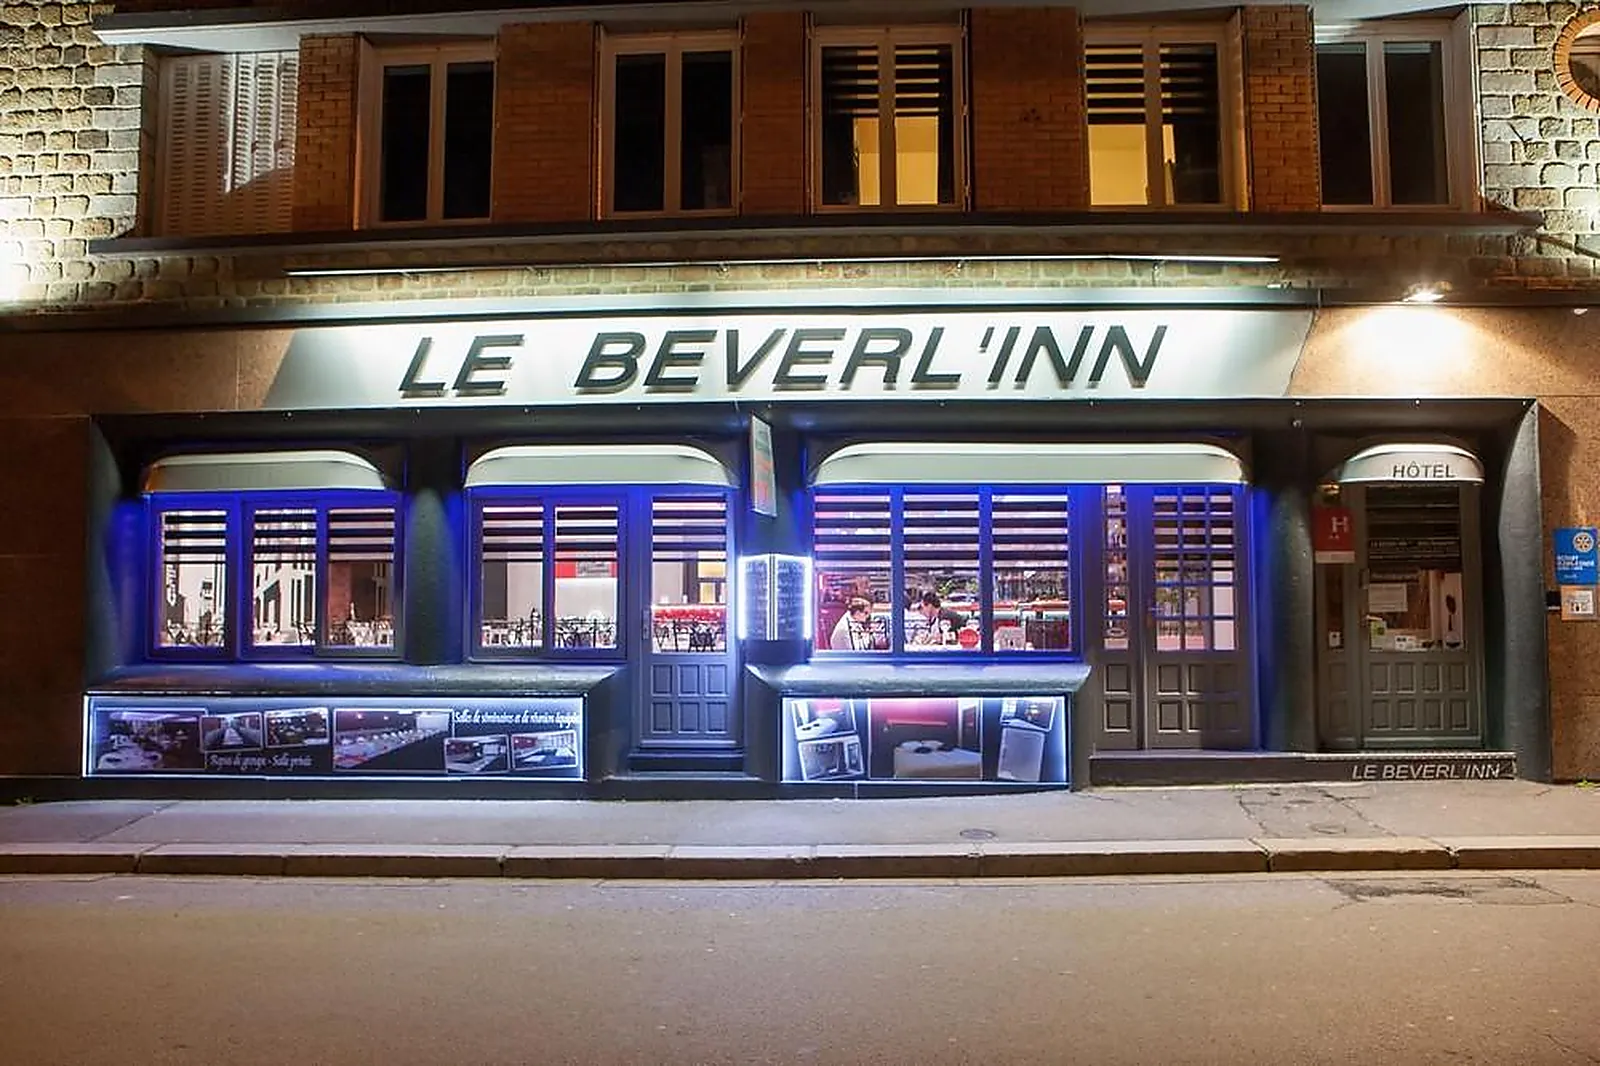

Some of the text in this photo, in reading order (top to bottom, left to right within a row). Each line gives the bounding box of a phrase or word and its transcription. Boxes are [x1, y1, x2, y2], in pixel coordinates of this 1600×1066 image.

[398, 325, 1169, 397] LE BEVERL'INN
[1392, 461, 1456, 478] HÔTEL
[1331, 516, 1348, 533] H
[1352, 763, 1501, 779] LE BEVERL'INN
